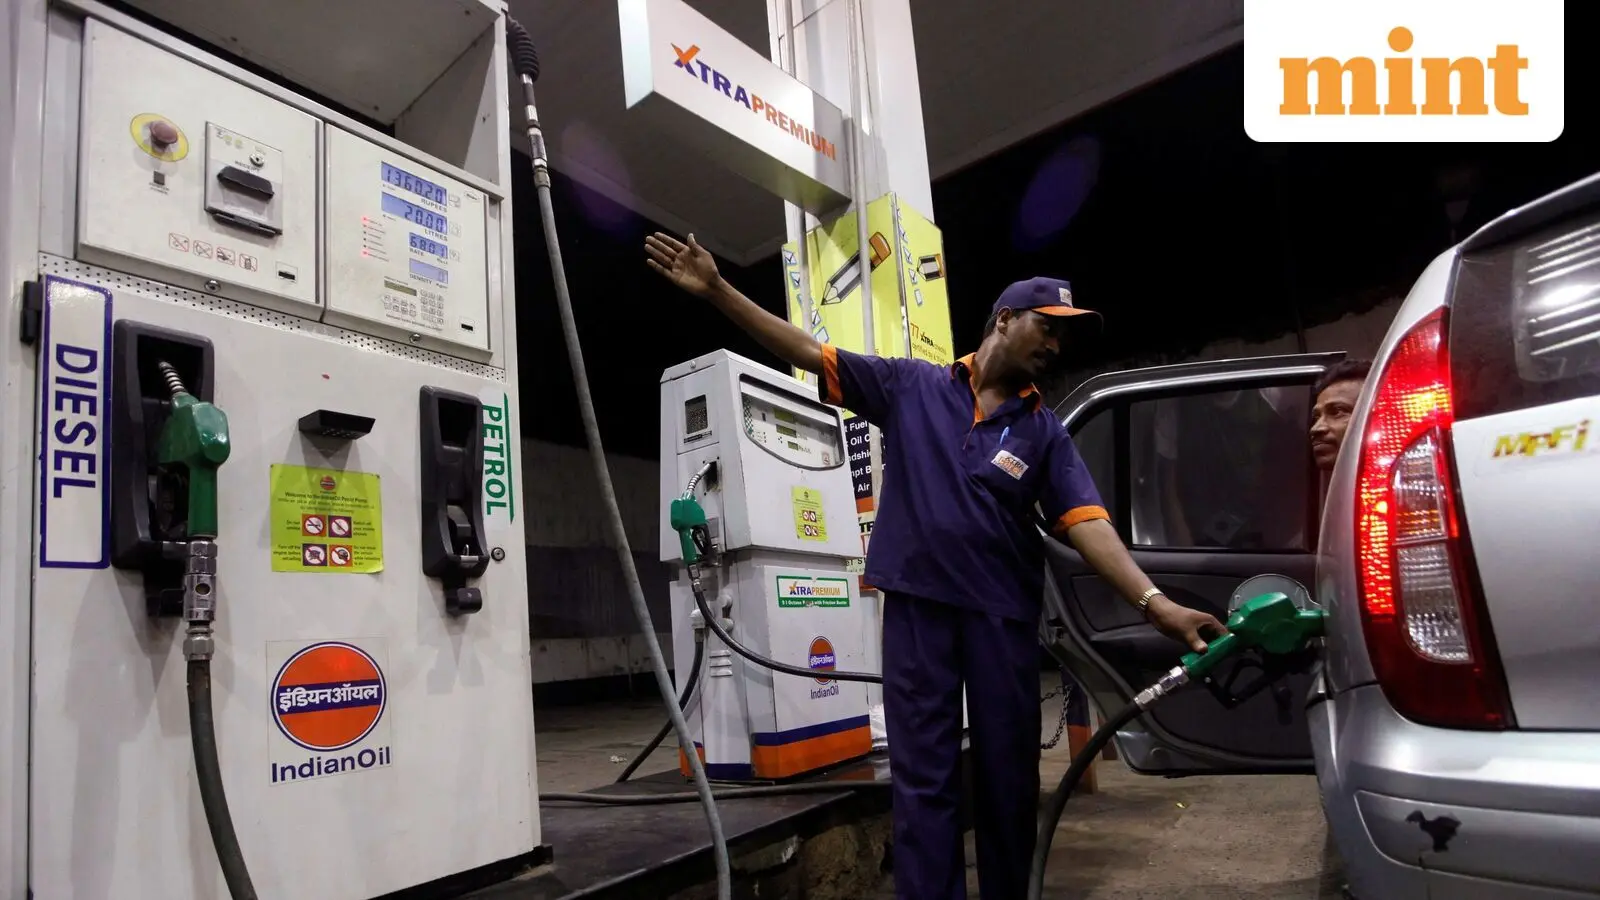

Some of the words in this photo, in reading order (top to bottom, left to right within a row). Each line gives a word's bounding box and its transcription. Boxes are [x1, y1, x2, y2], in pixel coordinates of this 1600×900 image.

[421, 198, 448, 213] RUPEES
[424, 228, 448, 241] LITRES
[53, 343, 98, 498] DIESEL
[850, 420, 868, 431] Fuel
[850, 435, 862, 446] Oil
[482, 404, 507, 515] PETROL
[857, 482, 870, 492] Air
[789, 581, 840, 595] XTRAPREMIUM
[279, 683, 380, 712] इंडियनऑयल
[811, 685, 839, 699] IndianOil
[271, 746, 391, 783] IndianOil
